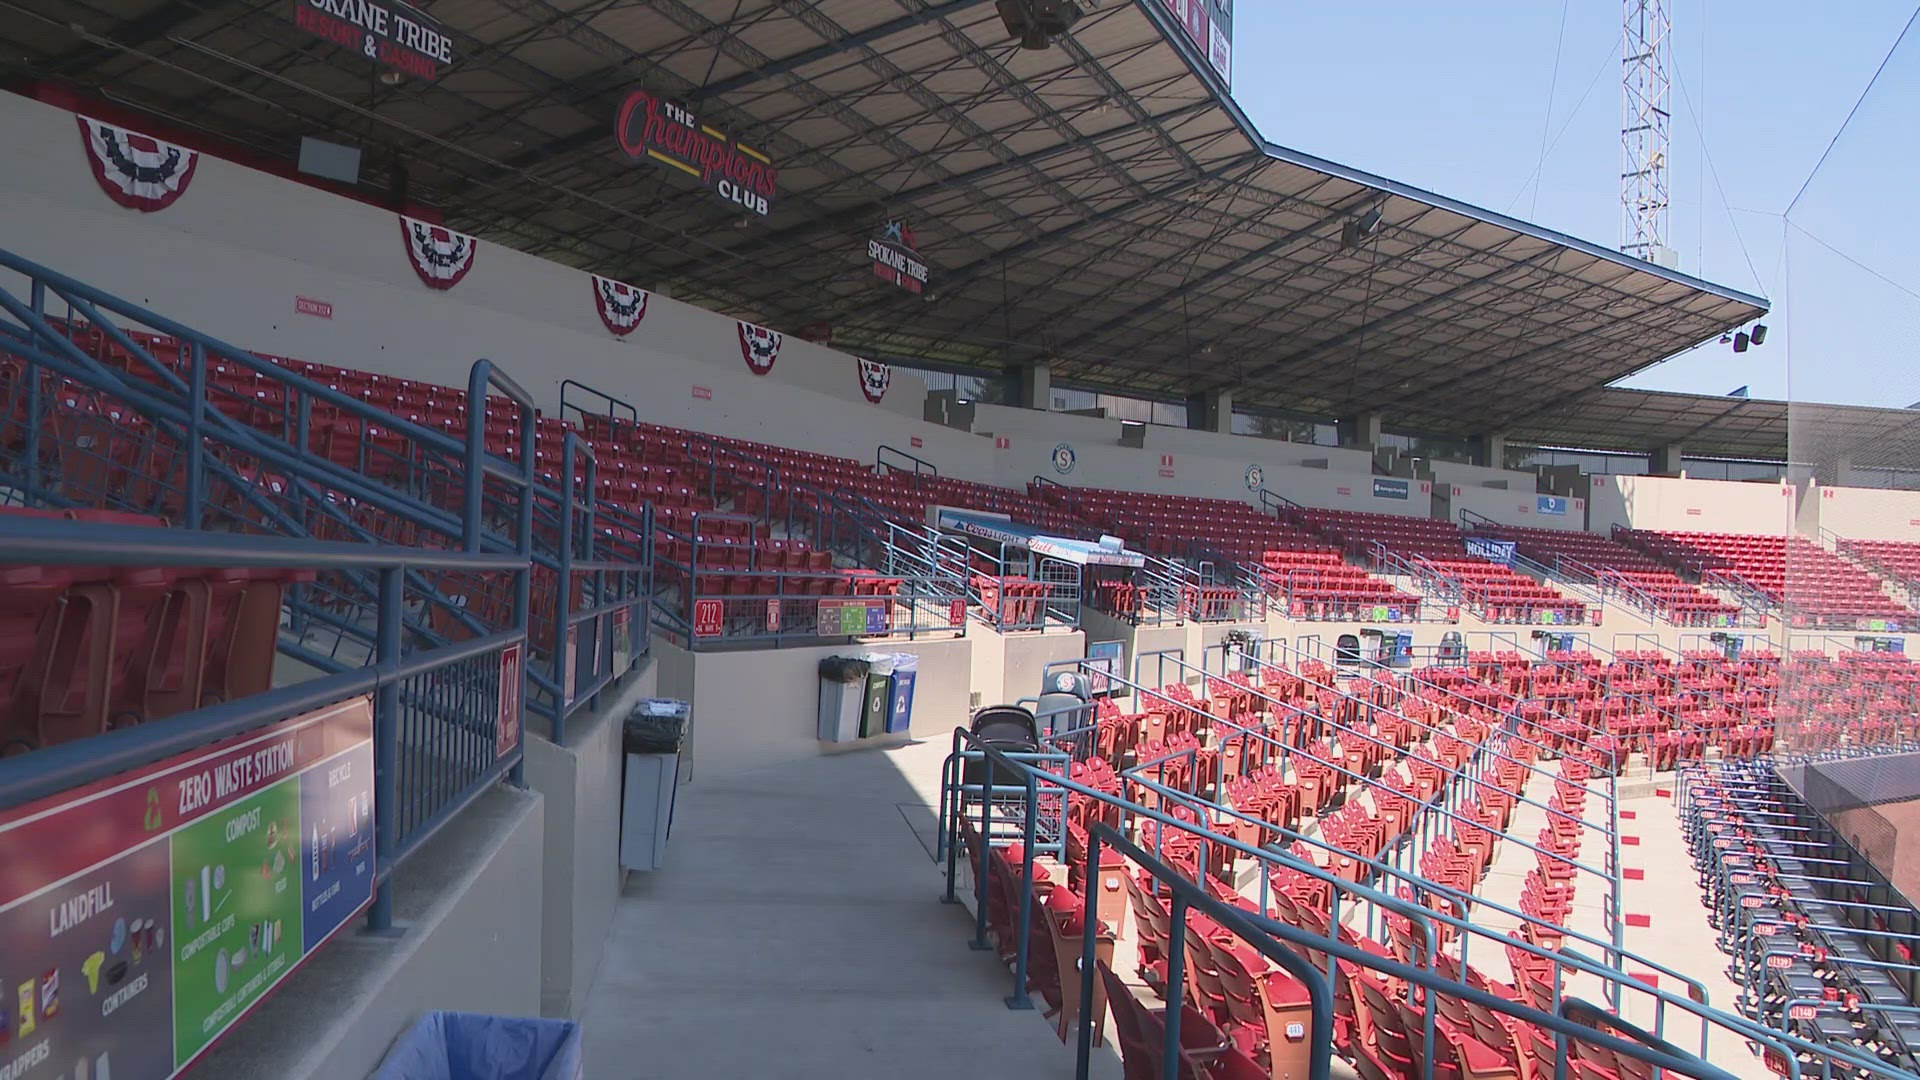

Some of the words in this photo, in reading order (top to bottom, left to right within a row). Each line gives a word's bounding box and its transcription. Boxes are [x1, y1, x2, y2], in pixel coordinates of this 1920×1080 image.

[297, 6, 363, 49] RESORT
[364, 34, 376, 58] &
[380, 41, 436, 80] CASINO
[394, 14, 452, 64] TRIBE
[664, 102, 695, 128] THE
[617, 90, 777, 196] Champions
[718, 180, 769, 216] CLUB
[868, 239, 906, 272] SPOKANE
[907, 257, 928, 283] TRIBE
[993, 531, 1019, 543] LIGHT
[1467, 541, 1513, 560] HOLLIDAY
[701, 603, 717, 624] 212
[178, 770, 212, 815] ZERO
[214, 755, 252, 799] WASTE
[254, 739, 295, 783] STATION
[328, 761, 352, 788] RECYCLE
[226, 806, 261, 843] COMPOST
[50, 881, 114, 938] LANDFILL
[102, 972, 149, 1017] CONTAINERS
